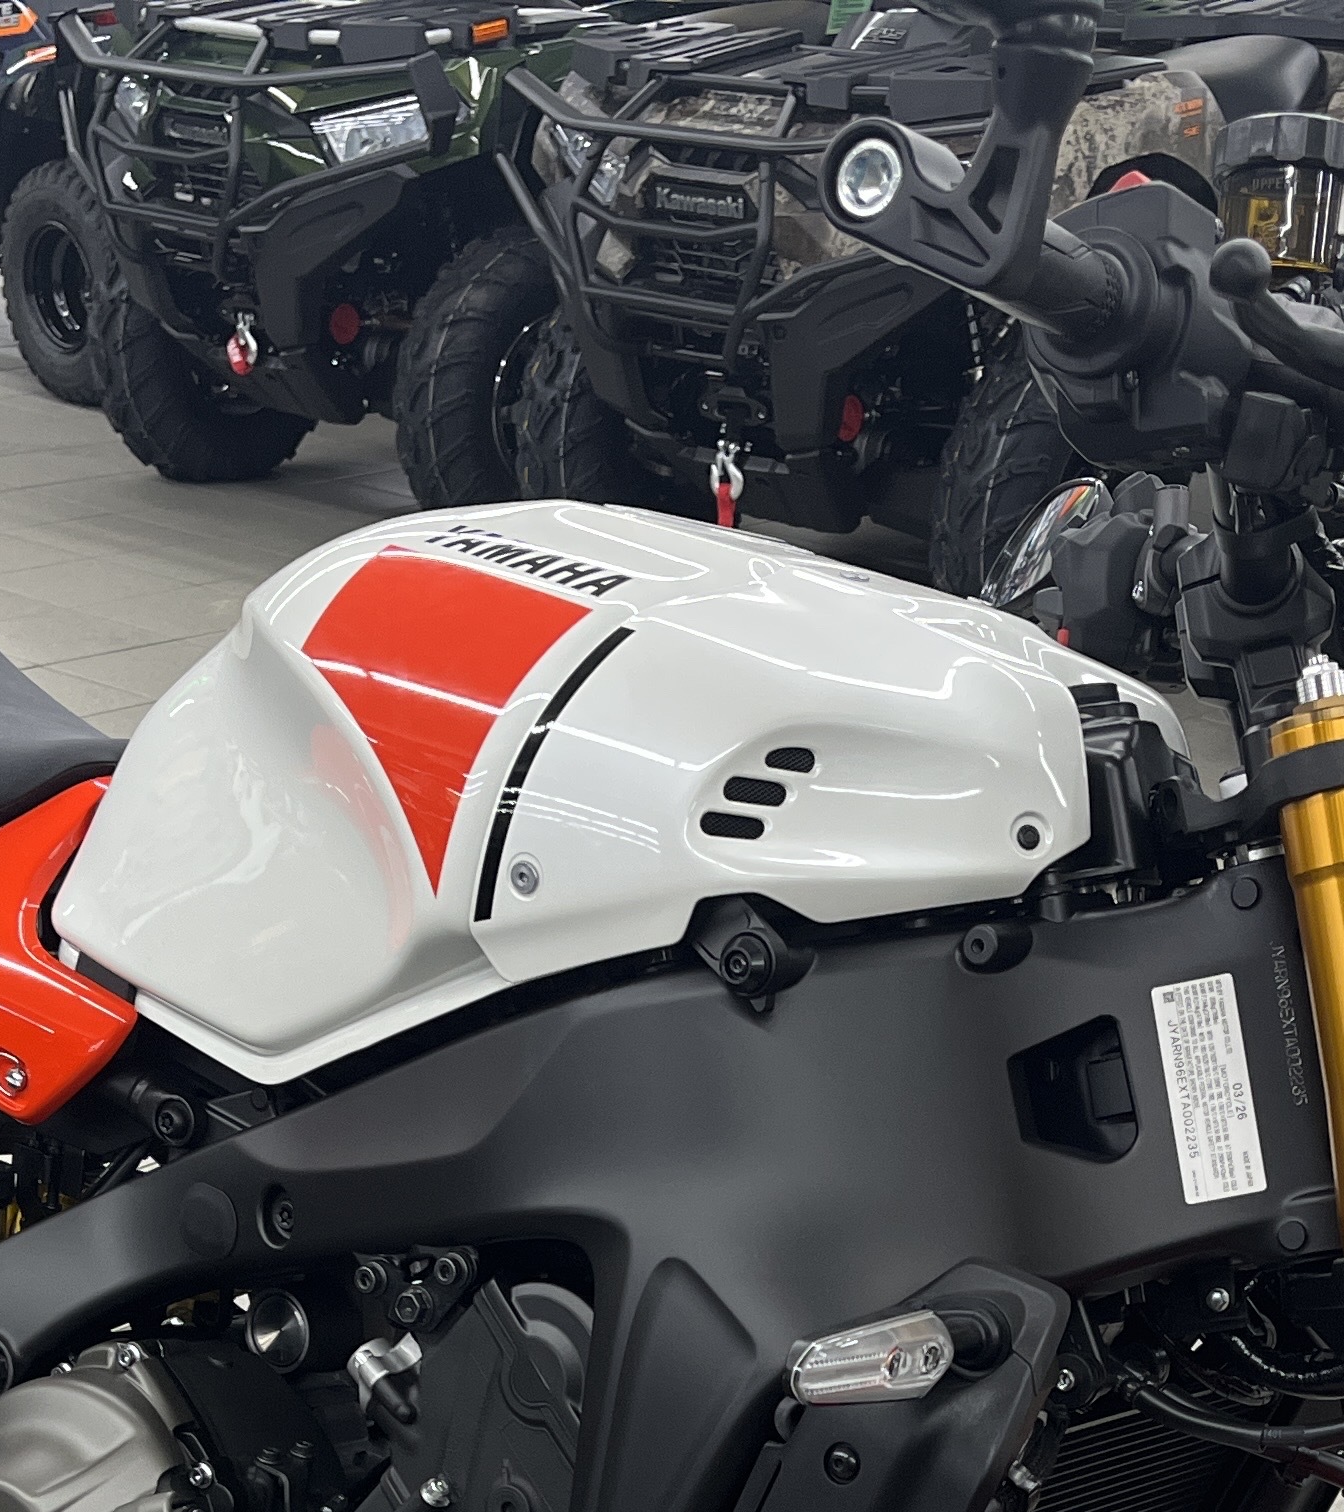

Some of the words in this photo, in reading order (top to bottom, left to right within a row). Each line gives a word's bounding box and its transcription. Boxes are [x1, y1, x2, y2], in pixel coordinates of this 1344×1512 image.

[425, 525, 633, 598] YAMAHA
[1167, 1019, 1200, 1159] JYARN96EXTA002235
[1232, 1082, 1248, 1120] 03/26
